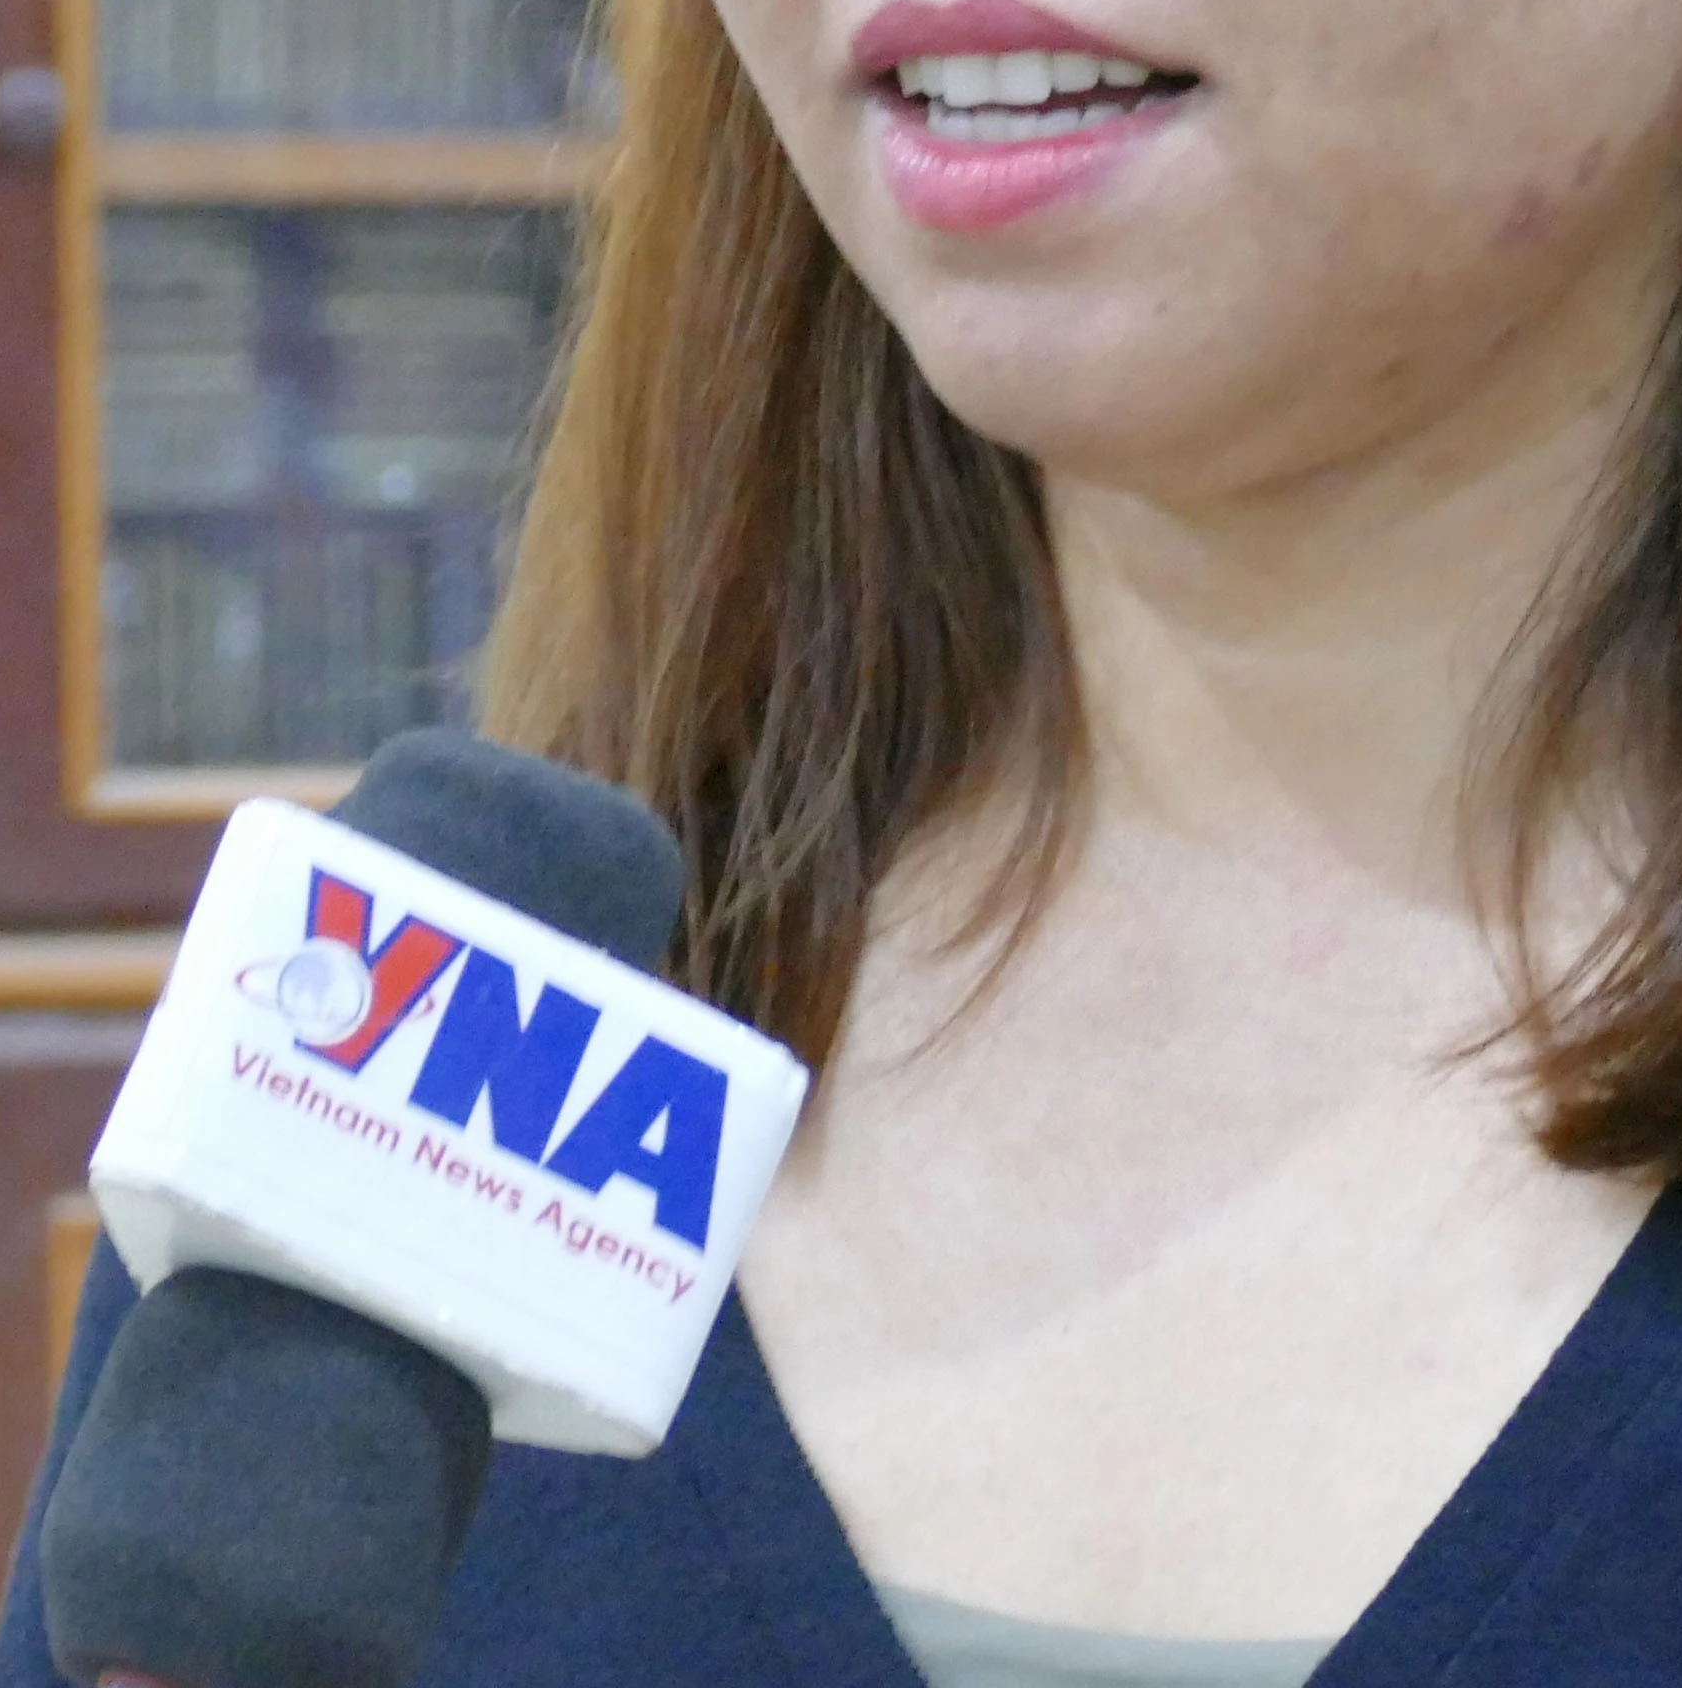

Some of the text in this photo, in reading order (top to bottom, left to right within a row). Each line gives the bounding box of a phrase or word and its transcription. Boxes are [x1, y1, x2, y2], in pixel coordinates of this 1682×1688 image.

[231, 1043, 697, 1303] Vietnam News Agency
[294, 865, 729, 1254] VNA
